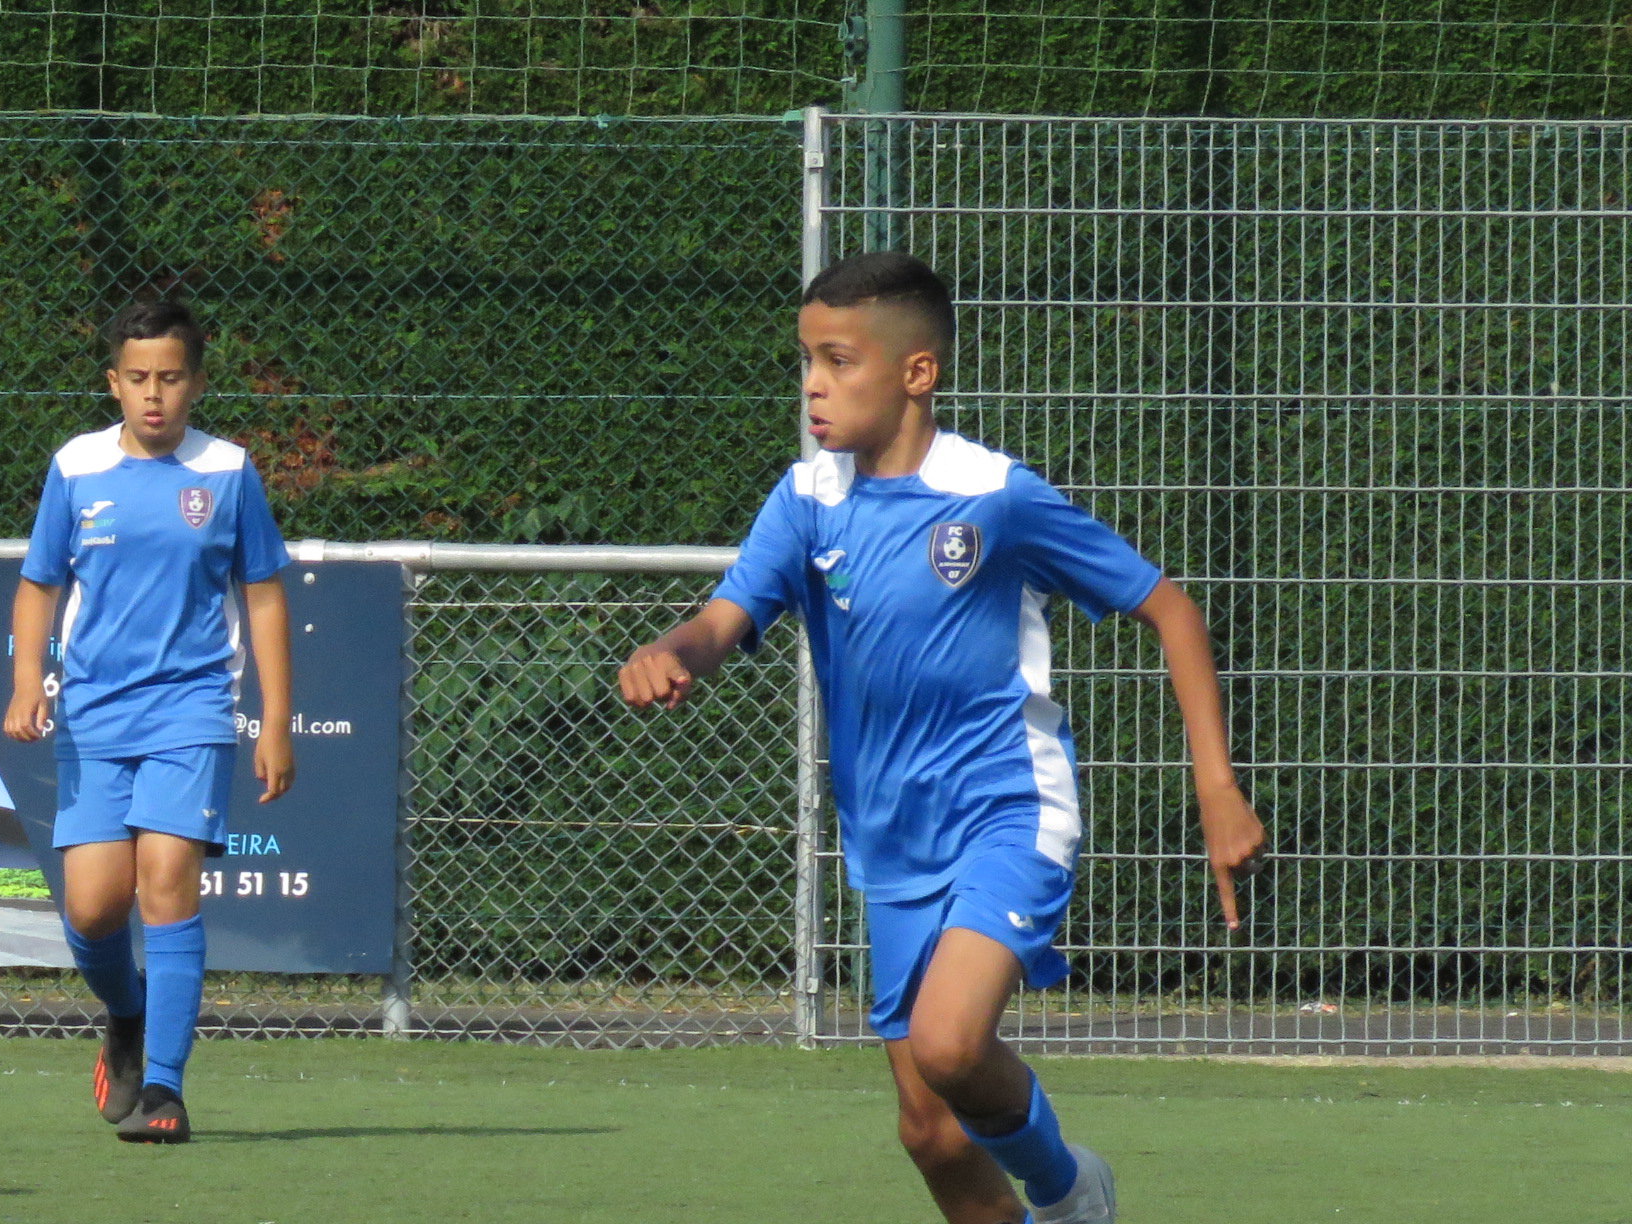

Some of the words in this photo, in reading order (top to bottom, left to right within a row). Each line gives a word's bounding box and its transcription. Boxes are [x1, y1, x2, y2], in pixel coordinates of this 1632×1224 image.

[948, 526, 963, 536] FC
[43, 672, 60, 697] 6
[227, 834, 281, 855] EIRA
[237, 871, 263, 895] 51
[279, 872, 309, 895] 15
